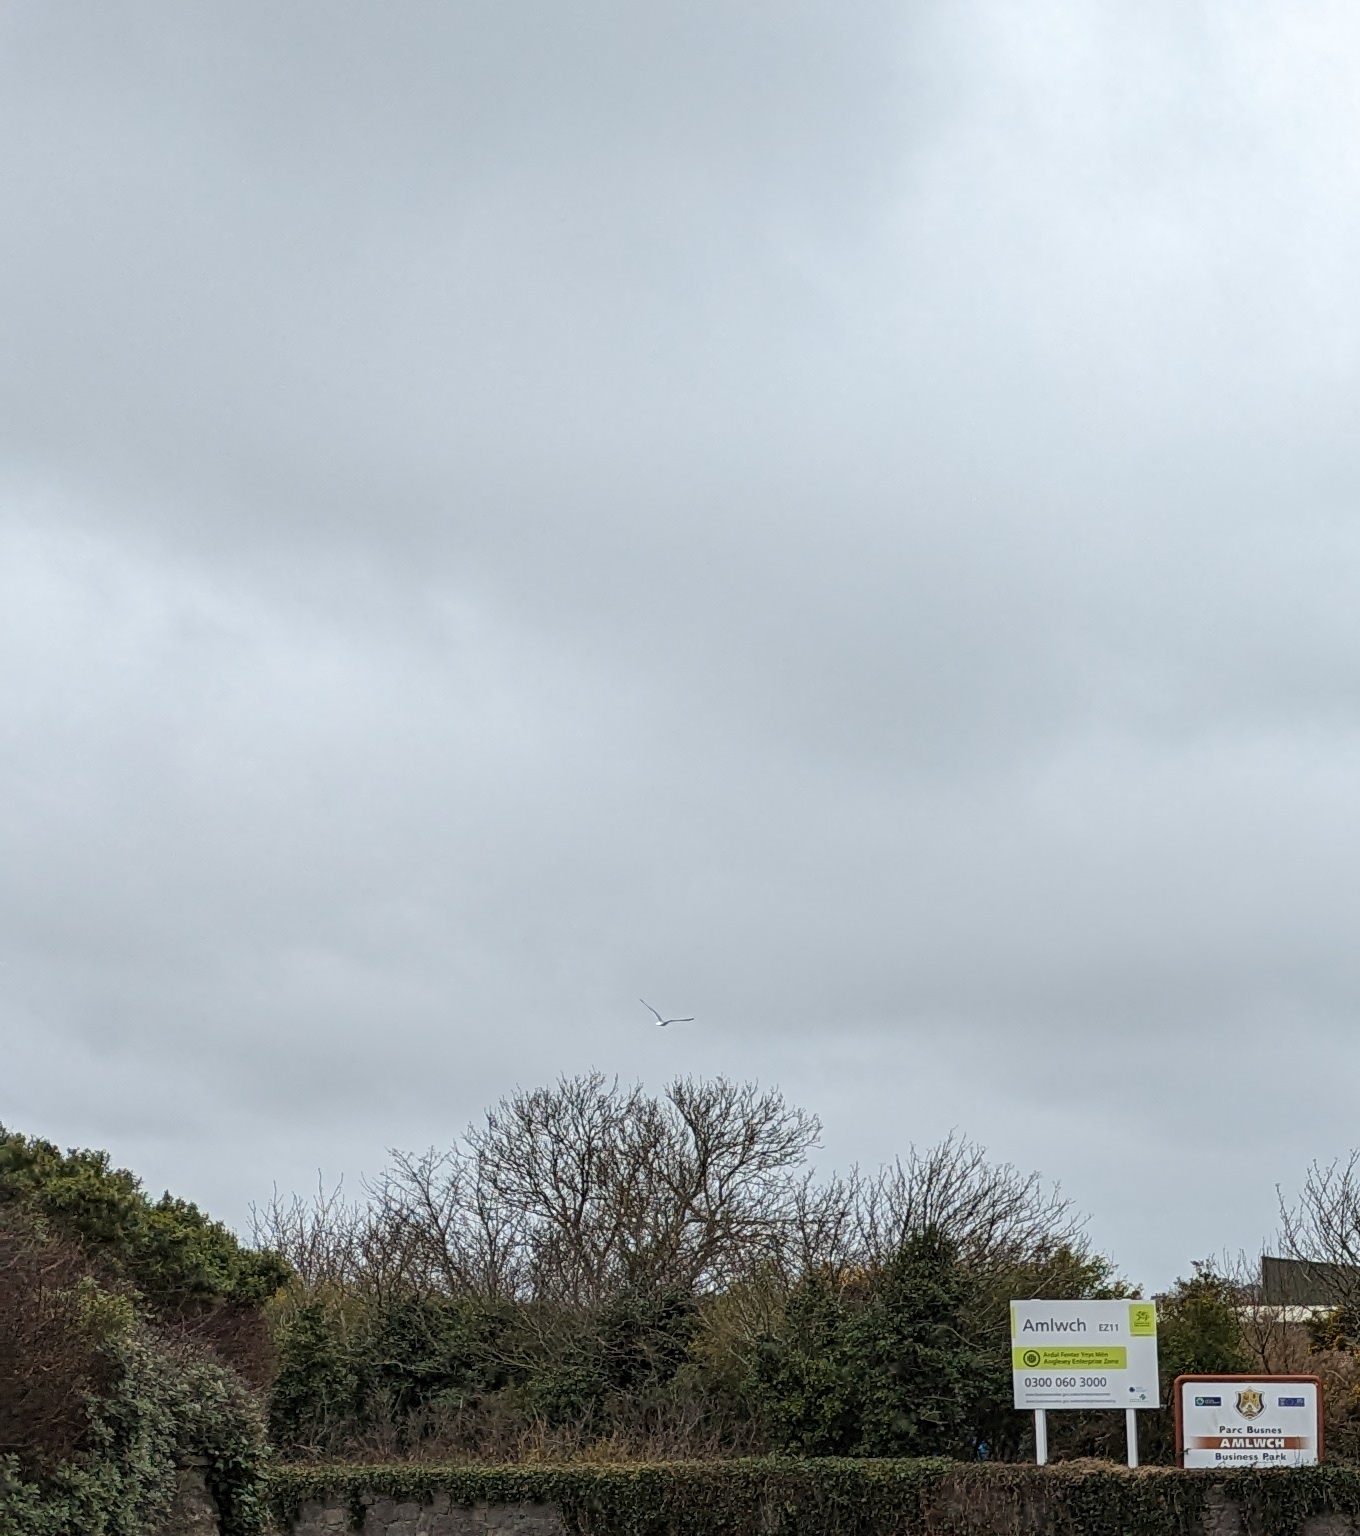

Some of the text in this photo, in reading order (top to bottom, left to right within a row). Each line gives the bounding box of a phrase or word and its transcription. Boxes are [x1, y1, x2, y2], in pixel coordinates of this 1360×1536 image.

[1022, 1317, 1087, 1332] Amlwch
[1098, 1323, 1119, 1332] EZ11
[1024, 1377, 1107, 1388] 0300 060 3000
[1219, 1425, 1283, 1434] Parc Busnes
[1219, 1438, 1285, 1449] AMLWCH
[1214, 1452, 1287, 1461] Business Park
